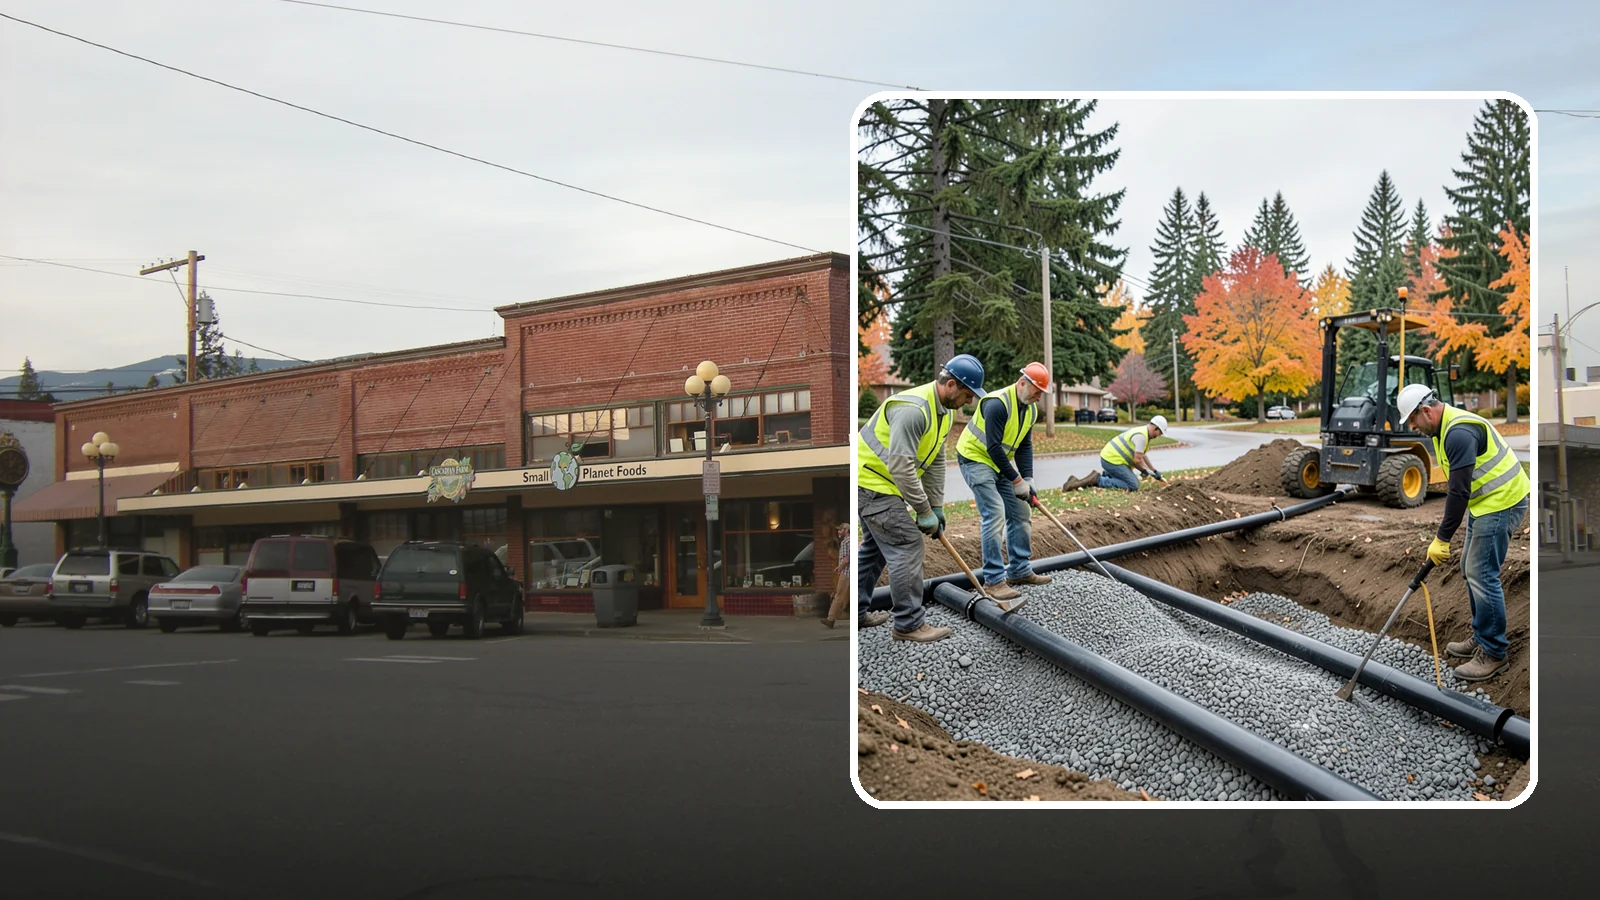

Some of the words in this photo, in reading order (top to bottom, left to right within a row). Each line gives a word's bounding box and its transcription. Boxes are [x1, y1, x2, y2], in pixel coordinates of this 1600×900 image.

[523, 470, 549, 483] Small
[583, 467, 614, 479] Planet
[617, 464, 647, 477] Foods
